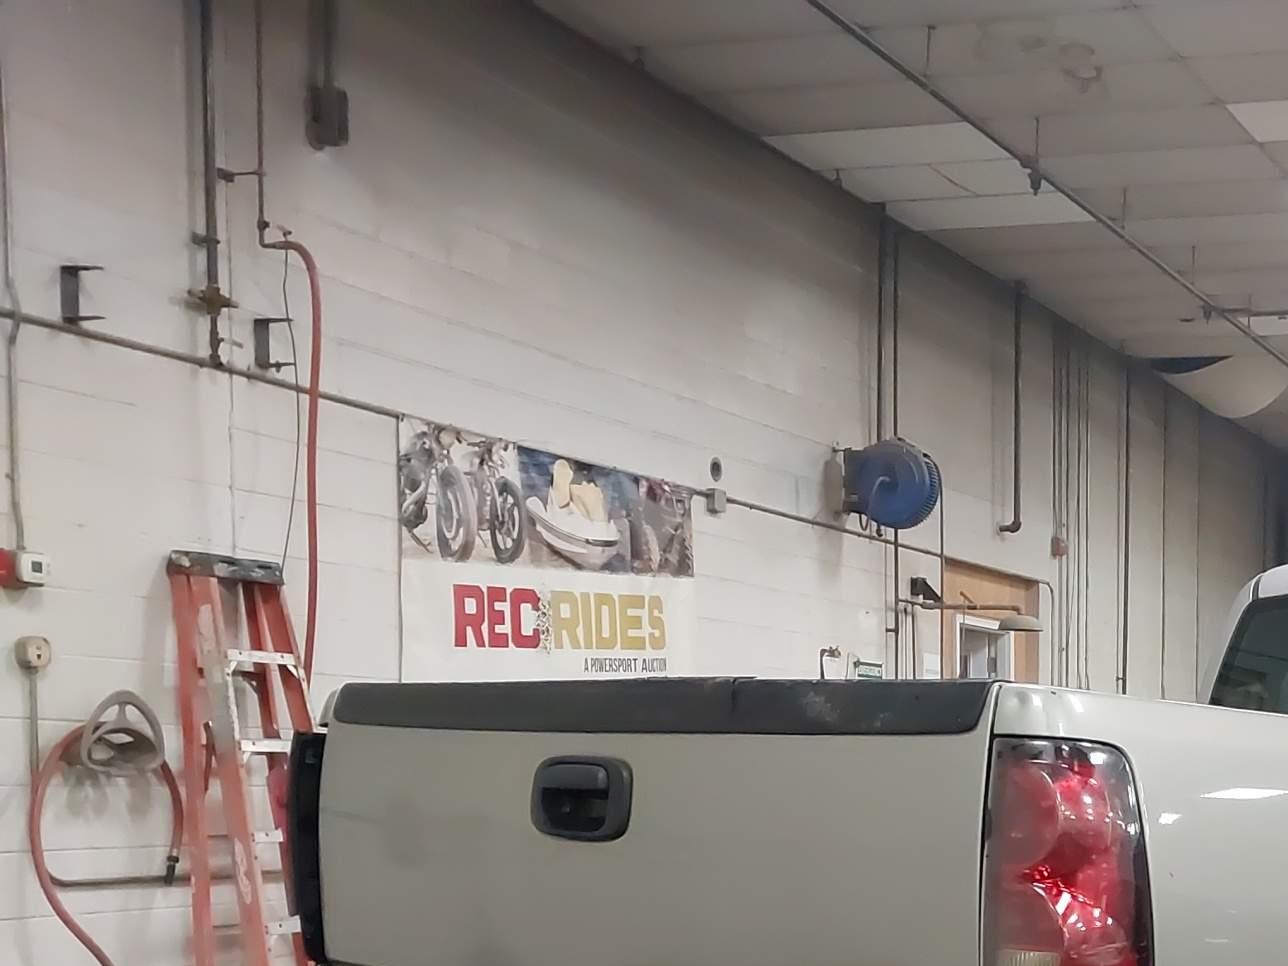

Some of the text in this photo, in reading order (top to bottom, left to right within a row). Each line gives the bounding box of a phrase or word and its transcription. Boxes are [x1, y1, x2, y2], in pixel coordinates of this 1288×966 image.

[453, 583, 667, 651] REC RIDES
[583, 657, 667, 673] A POWERSPORT AUCTION
